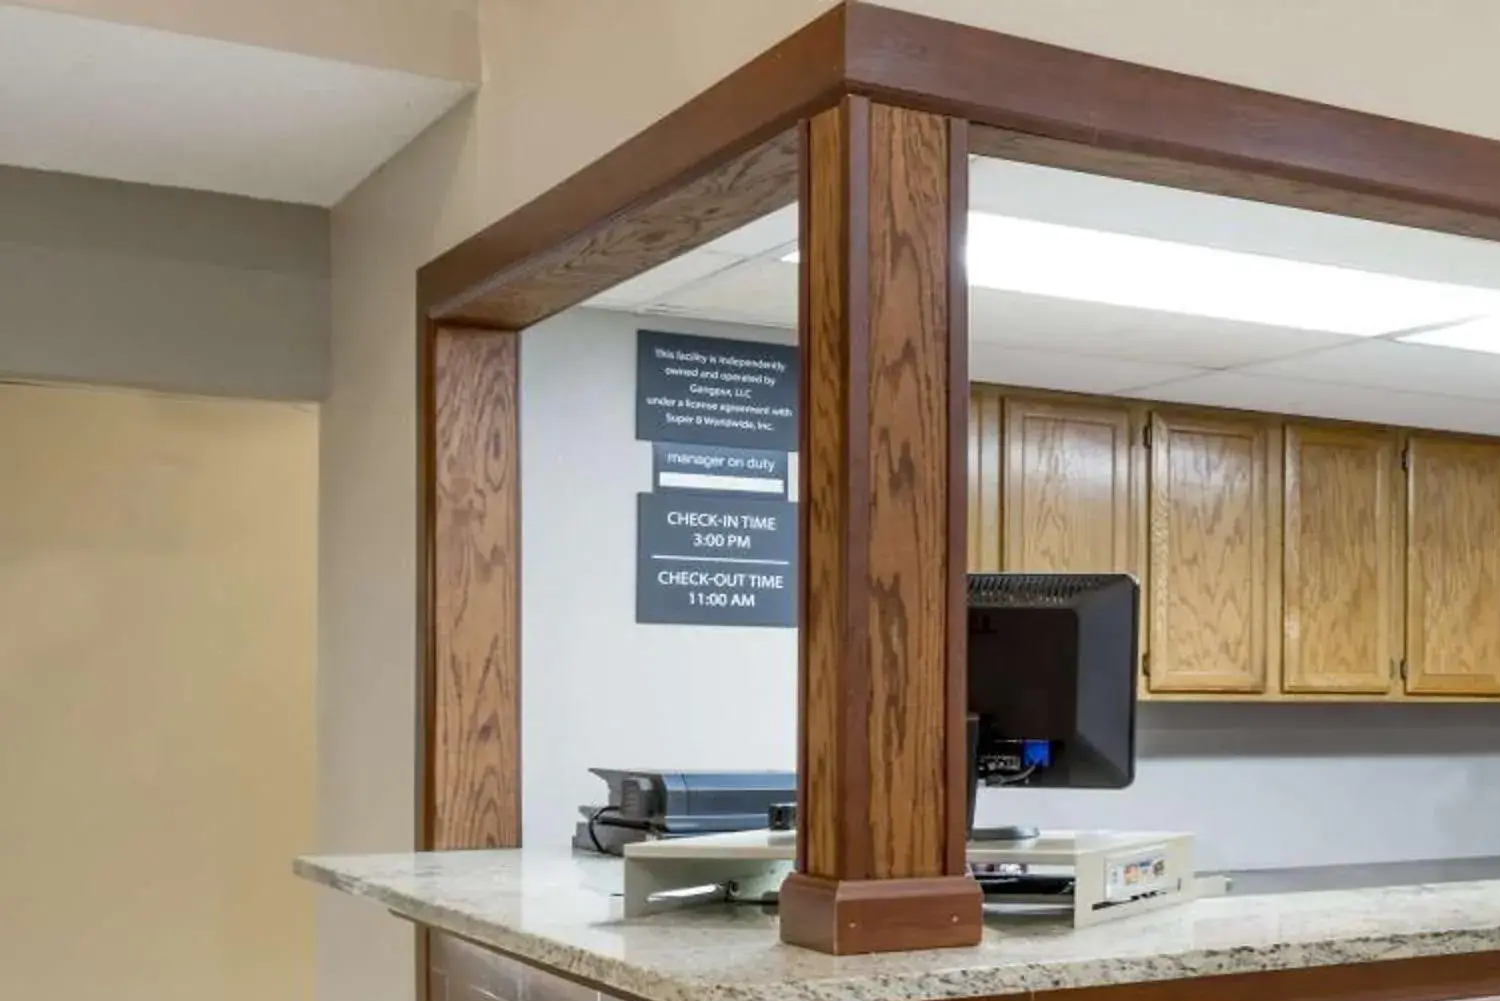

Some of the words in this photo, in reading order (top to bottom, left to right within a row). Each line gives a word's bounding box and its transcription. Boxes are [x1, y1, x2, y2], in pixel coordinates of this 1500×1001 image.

[655, 348, 674, 359] This
[700, 370, 718, 379] and
[764, 375, 776, 387] by
[734, 388, 752, 399] LLC
[665, 412, 694, 425] Super
[666, 452, 724, 468] manager
[727, 457, 744, 467] on
[746, 458, 777, 472] duty
[667, 511, 739, 529] CHECK-IN
[741, 515, 777, 531] TIME
[693, 533, 725, 547] 3:00
[727, 535, 752, 549] PM
[657, 570, 747, 587] CHECK-OUT
[749, 574, 784, 590] TIME
[688, 591, 727, 606] 11:00
[730, 593, 756, 608] AM
